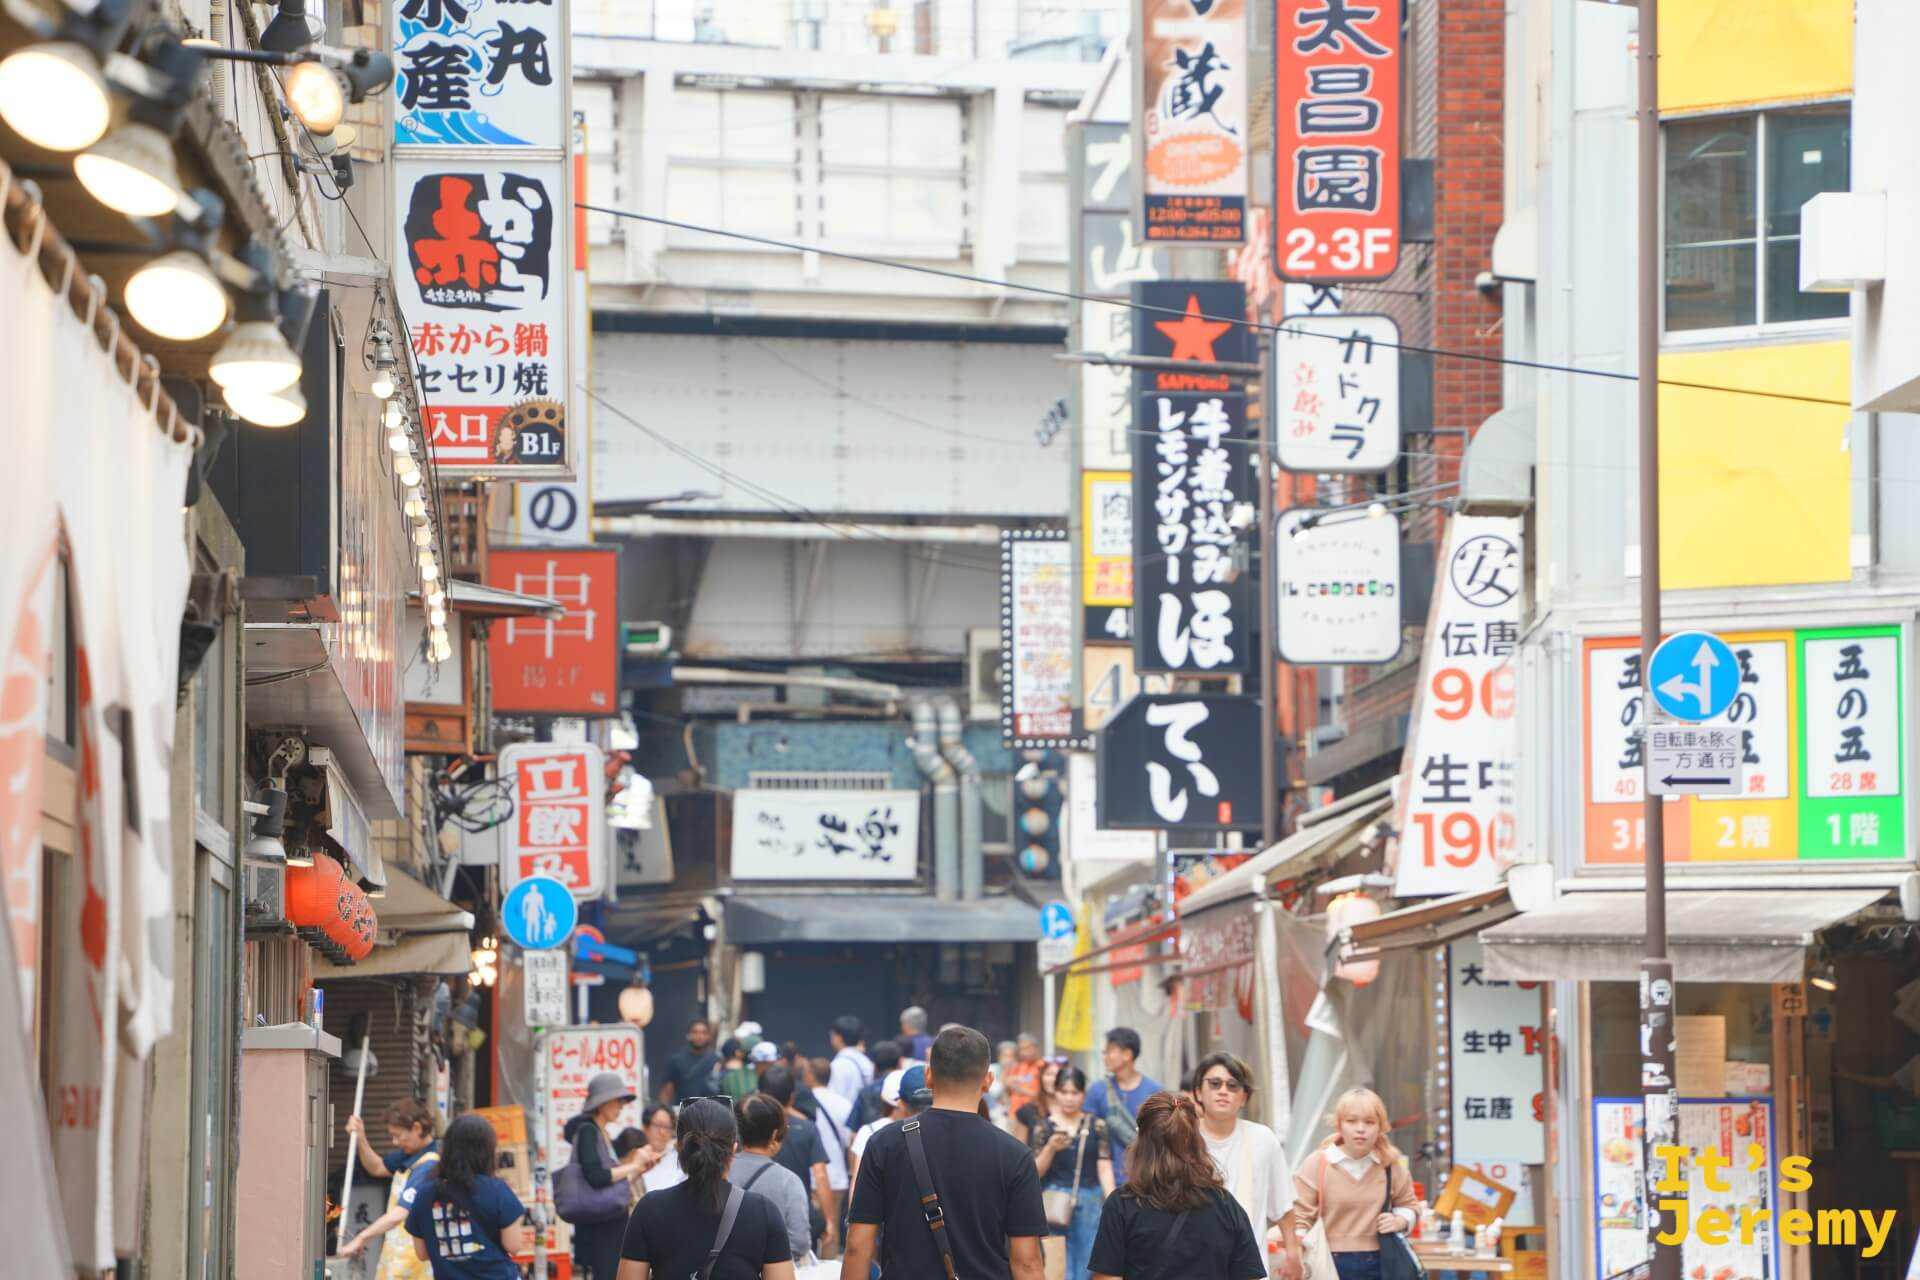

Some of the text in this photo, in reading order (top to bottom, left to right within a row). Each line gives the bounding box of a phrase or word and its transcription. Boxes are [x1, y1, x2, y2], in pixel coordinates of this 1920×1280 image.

[485, 0, 552, 86] 丸
[411, 322, 548, 357] 赤から鍋
[415, 362, 549, 396] セセリ焼
[1331, 329, 1381, 460] カドクラ
[428, 411, 489, 443] 入口
[521, 432, 561, 455] B1F
[1156, 398, 1190, 585] レモンサワー
[1188, 398, 1236, 584] 牛煮込み
[529, 487, 577, 532] の
[1105, 608, 1134, 637] 4
[1833, 644, 1871, 764] 五の五
[1653, 731, 1737, 748] 自転車を除く
[1653, 752, 1737, 769] 一方通行
[1611, 818, 1645, 850] 3
[1826, 812, 1880, 847] 1階
[1463, 1029, 1512, 1054] 生中
[1464, 1096, 1513, 1121] 伝唐
